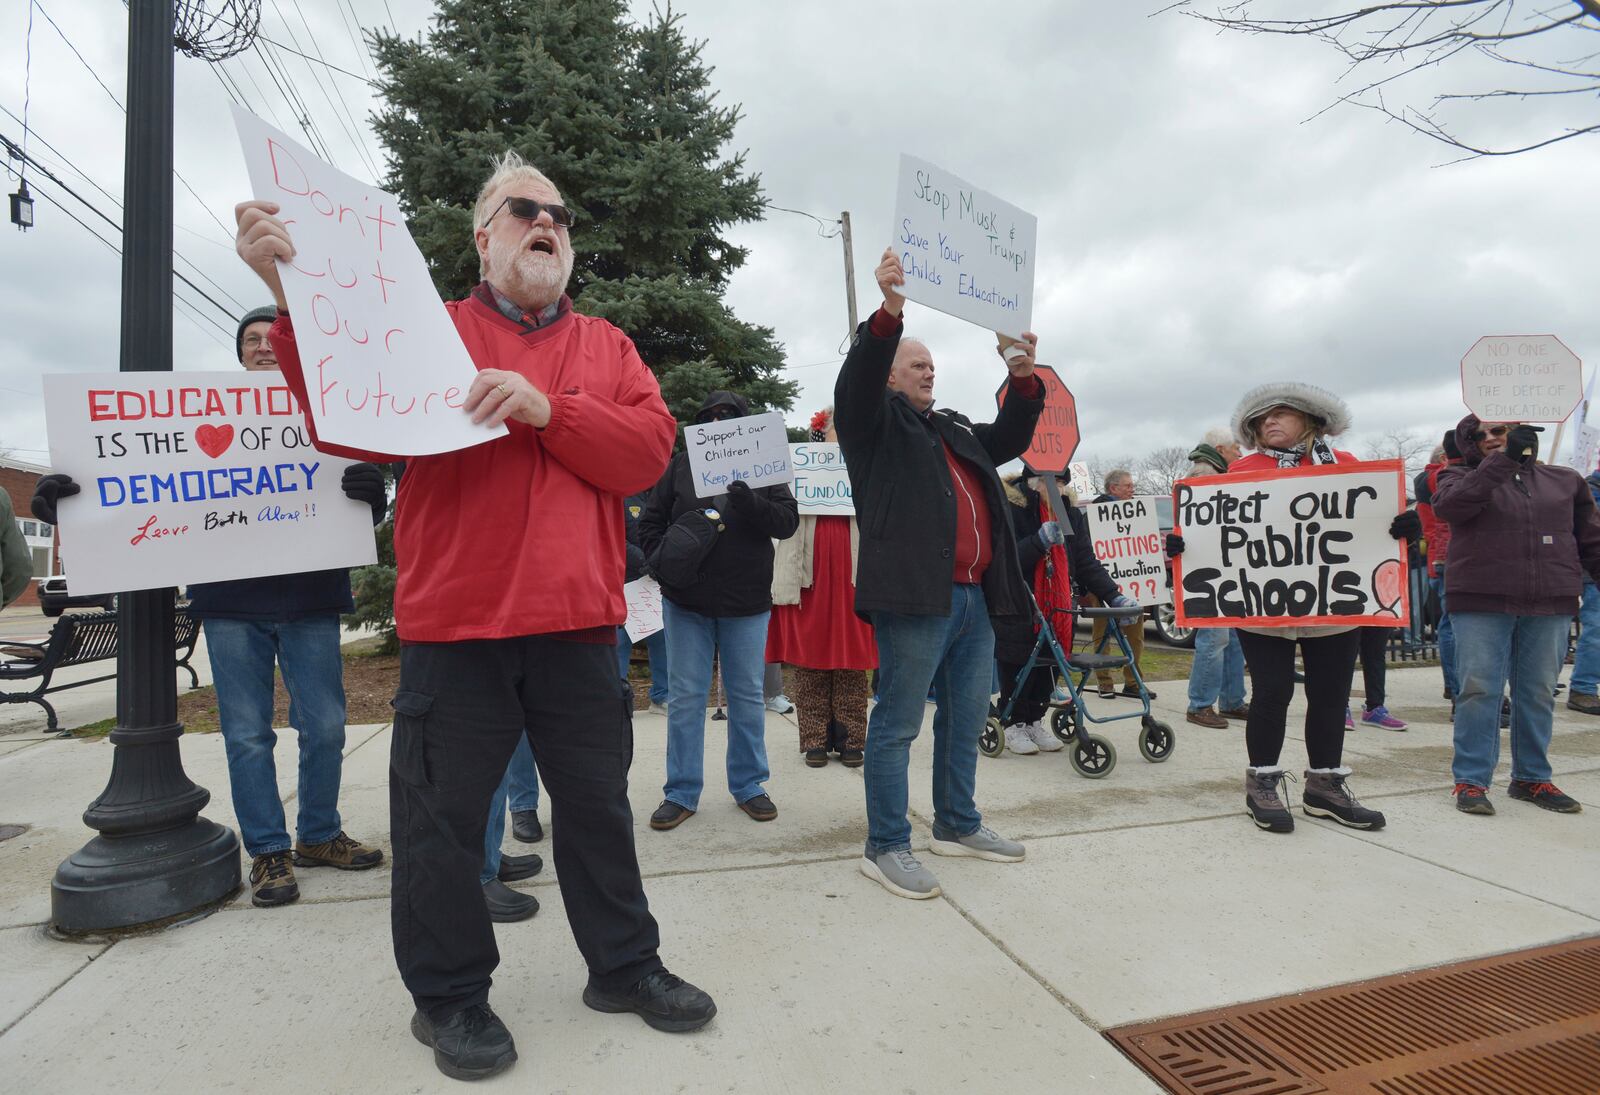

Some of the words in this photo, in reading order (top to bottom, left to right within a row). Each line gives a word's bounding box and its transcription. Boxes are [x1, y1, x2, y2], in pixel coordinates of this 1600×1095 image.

[267, 138, 396, 252] Don't
[915, 170, 950, 221] Stop
[959, 190, 998, 234] Musk
[901, 218, 929, 250] Save
[938, 232, 964, 265] Your
[986, 235, 1026, 272] Trump!
[901, 252, 942, 286] Childs
[958, 273, 1018, 312] Education!
[312, 294, 405, 354] Our
[1487, 342, 1510, 357] NO
[1518, 342, 1548, 357] ONE
[317, 355, 464, 417] Future
[1475, 362, 1513, 377] VOTED
[1517, 362, 1531, 376] TO
[1534, 362, 1560, 376] GUT
[87, 386, 302, 422] EDUCATIO
[1476, 385, 1501, 397] THE
[1547, 384, 1566, 397] OF
[1485, 403, 1561, 417] EDUCATION
[94, 432, 128, 459] IS
[135, 431, 188, 455] THE
[240, 426, 273, 450] OF
[281, 426, 311, 449] OU
[696, 425, 743, 446] Support
[748, 425, 767, 434] our
[1032, 432, 1063, 454] CUTS
[793, 446, 835, 466] STOP
[97, 462, 320, 508] DEMOCRACY
[702, 470, 728, 487] Keep
[732, 468, 750, 481] the
[795, 477, 835, 499] FUND
[1098, 500, 1146, 522] MAGA
[1175, 484, 1270, 526] Protect
[1290, 486, 1377, 520] our
[130, 515, 189, 541] Leave
[204, 505, 248, 526] Both
[1117, 522, 1131, 535] by
[1094, 533, 1160, 561] CUTTING
[1220, 521, 1354, 569] Public
[1183, 565, 1369, 618] Schools
